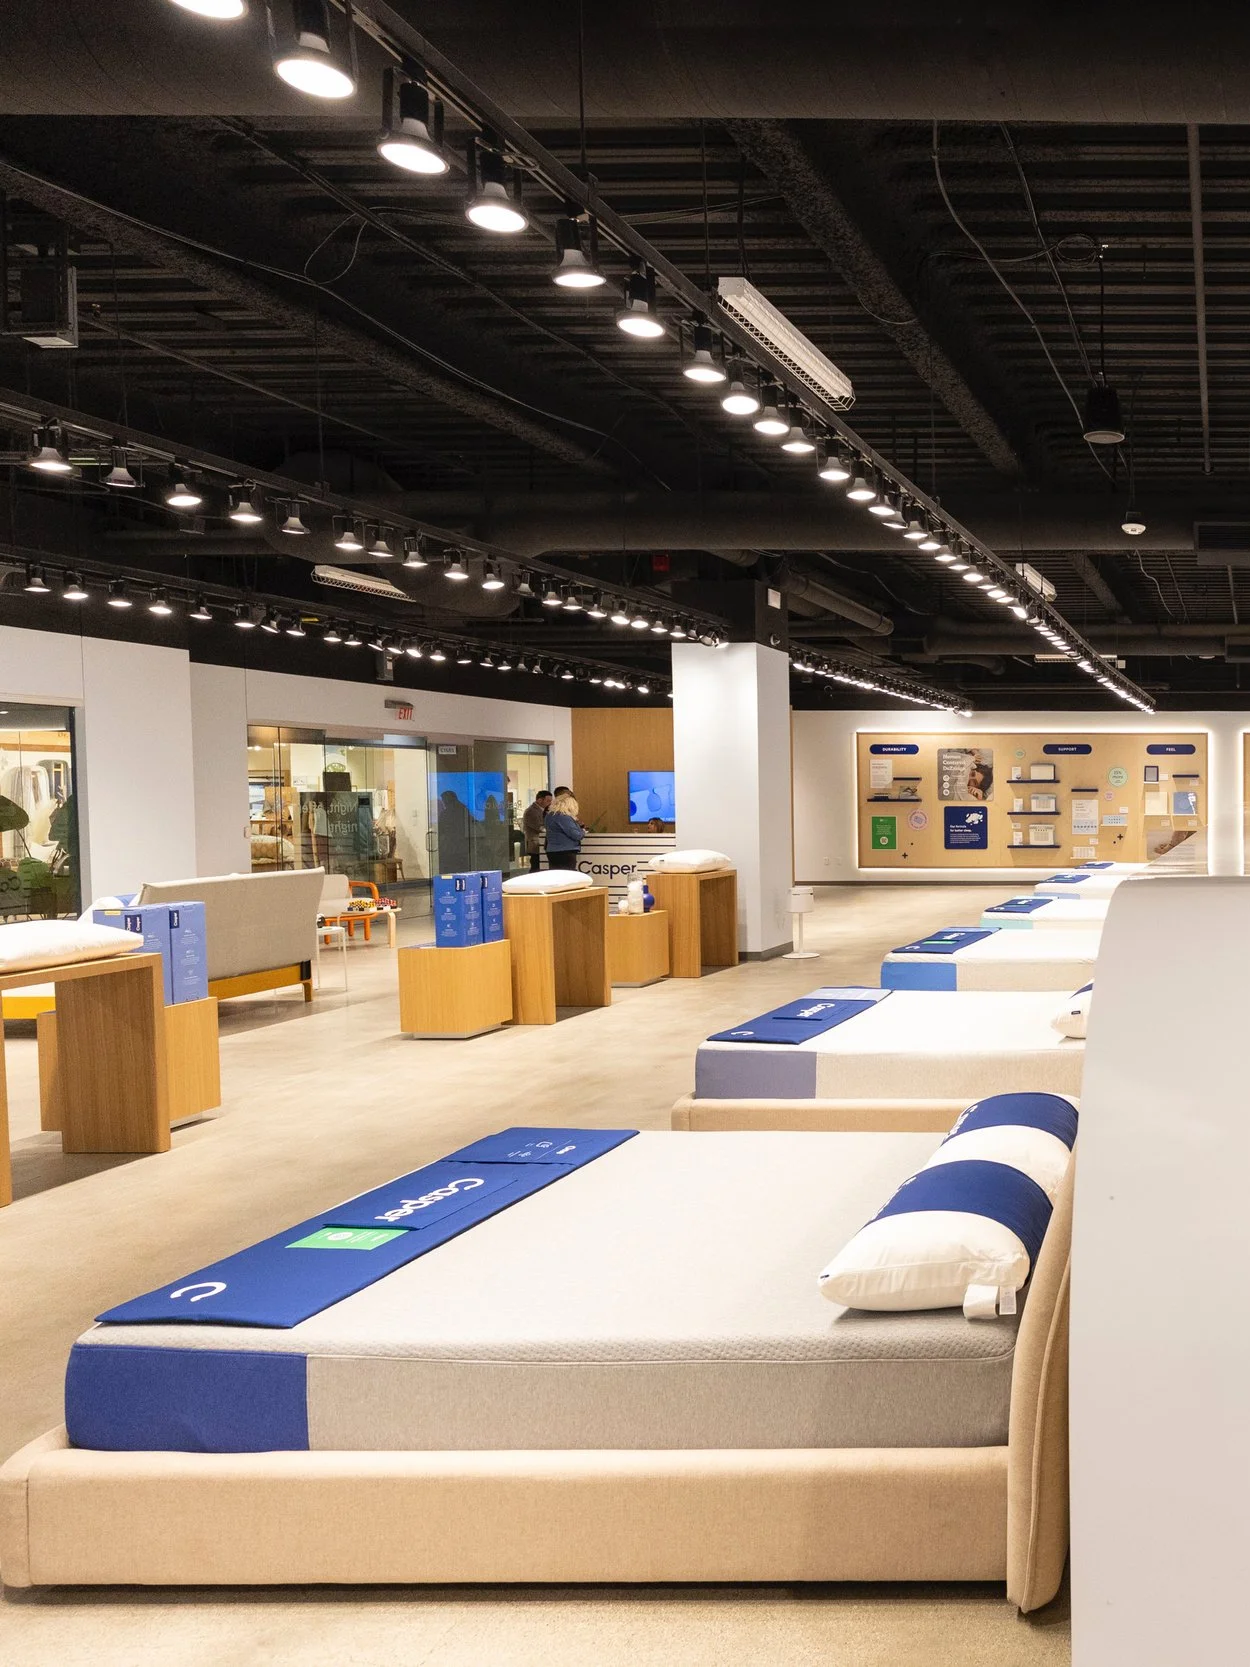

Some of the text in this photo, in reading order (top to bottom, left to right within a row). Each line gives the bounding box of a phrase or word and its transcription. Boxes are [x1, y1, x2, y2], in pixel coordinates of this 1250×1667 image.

[398, 707, 413, 720] EXIT
[578, 860, 637, 880] Casper
[374, 1177, 485, 1222] Casper
